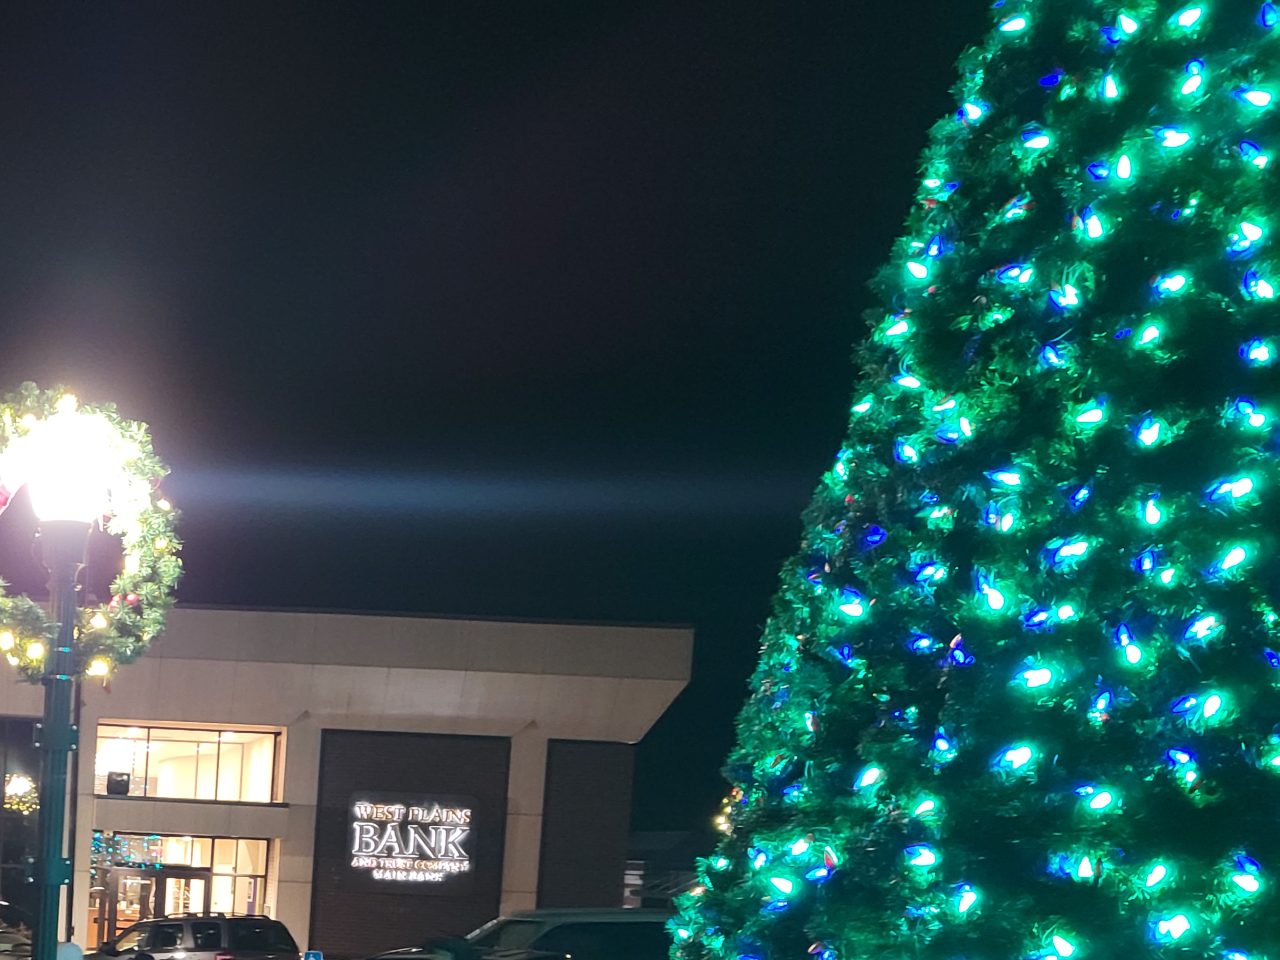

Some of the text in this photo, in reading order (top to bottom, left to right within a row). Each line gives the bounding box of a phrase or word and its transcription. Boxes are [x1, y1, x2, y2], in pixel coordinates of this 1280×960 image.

[354, 803, 472, 824] WEST PLAINS
[352, 822, 470, 859] BANK
[351, 856, 470, 873] AND TRUST COMPANY
[372, 869, 444, 882] MAIN BANK
